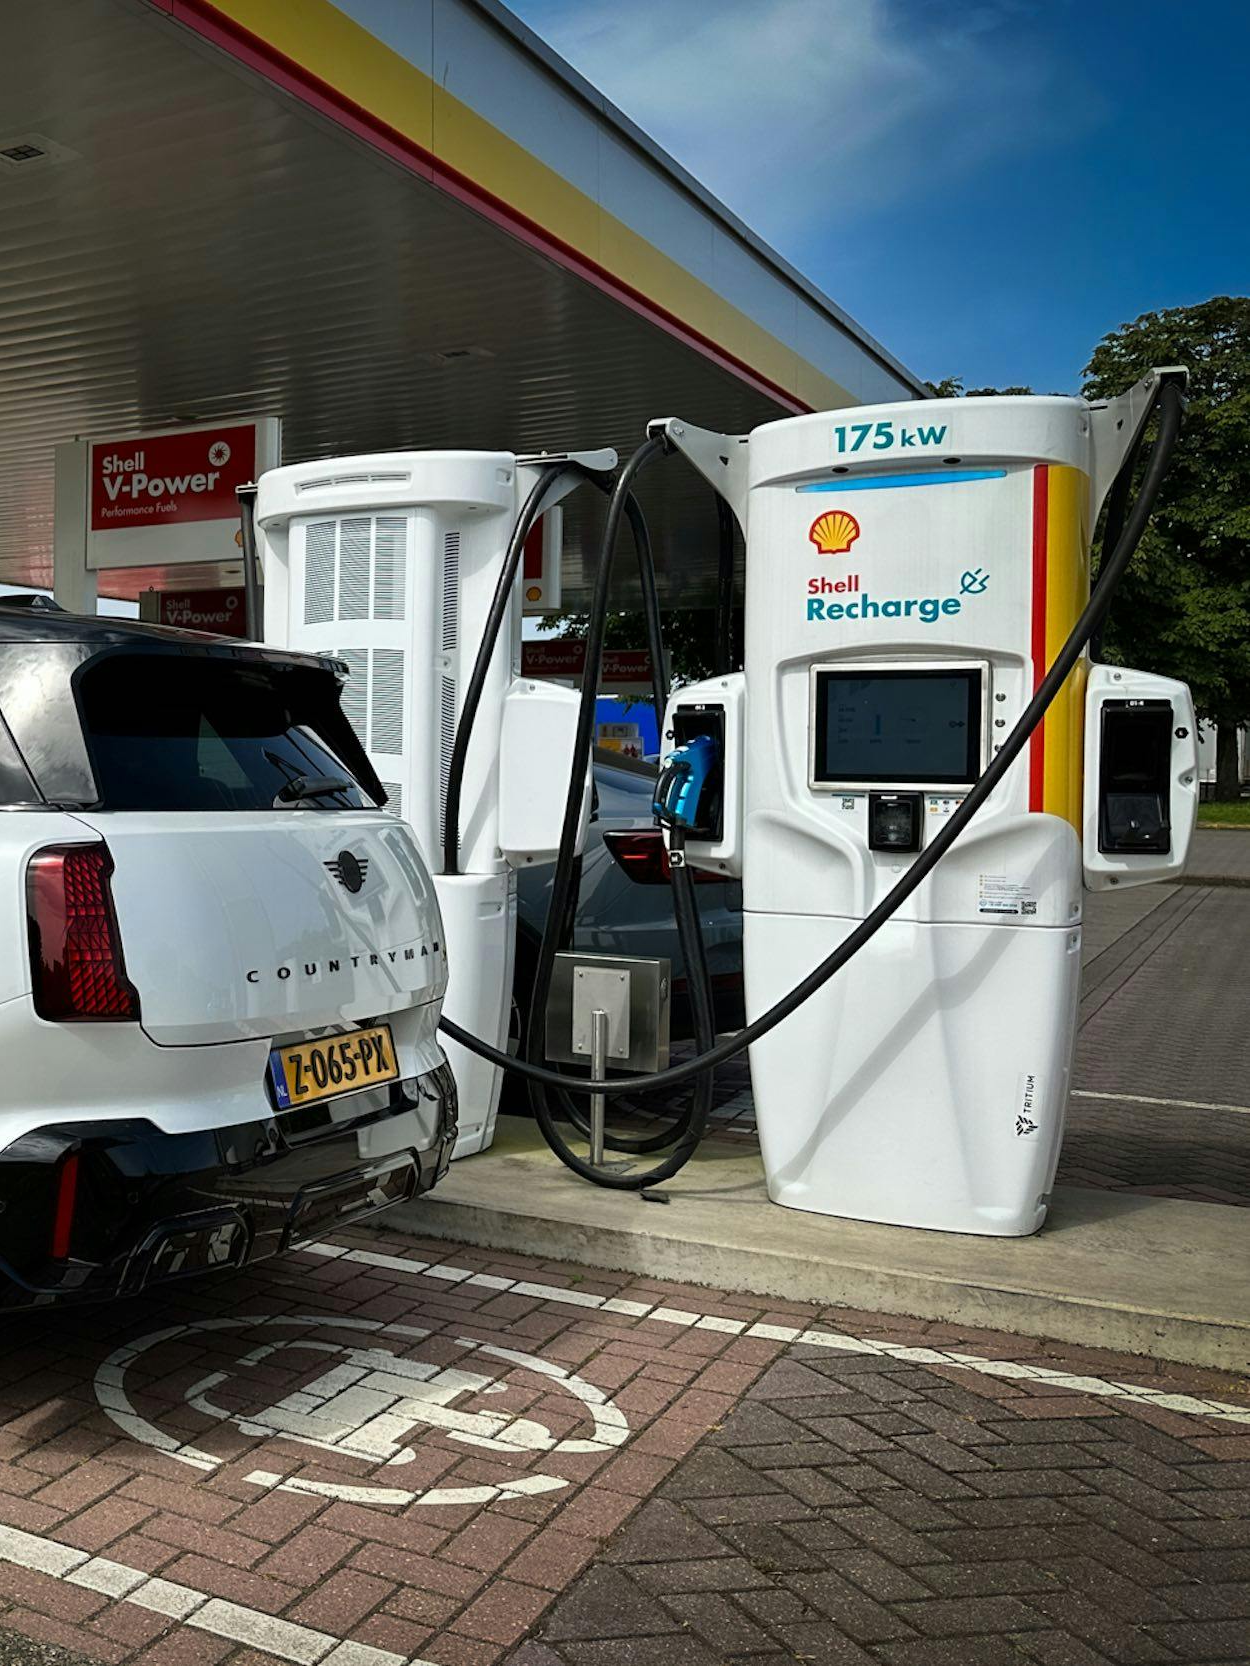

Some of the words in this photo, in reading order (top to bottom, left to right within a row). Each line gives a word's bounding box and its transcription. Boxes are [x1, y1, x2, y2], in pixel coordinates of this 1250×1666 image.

[834, 421, 894, 453] 175
[900, 425, 948, 447] kW
[102, 450, 145, 475] Shell
[102, 471, 221, 501] V-Power
[101, 504, 154, 518] Performance
[155, 501, 178, 513] Fuels
[807, 574, 859, 595] Shell
[166, 597, 190, 610] Shell
[806, 593, 962, 624] Recharge
[166, 609, 233, 624] V-Power
[525, 654, 580, 665] V-Power
[246, 941, 440, 984] COUNTRYMAN
[288, 1034, 390, 1096] Z-065-PX
[276, 1084, 288, 1098] NL
[1023, 1075, 1036, 1113] TRITIUM
